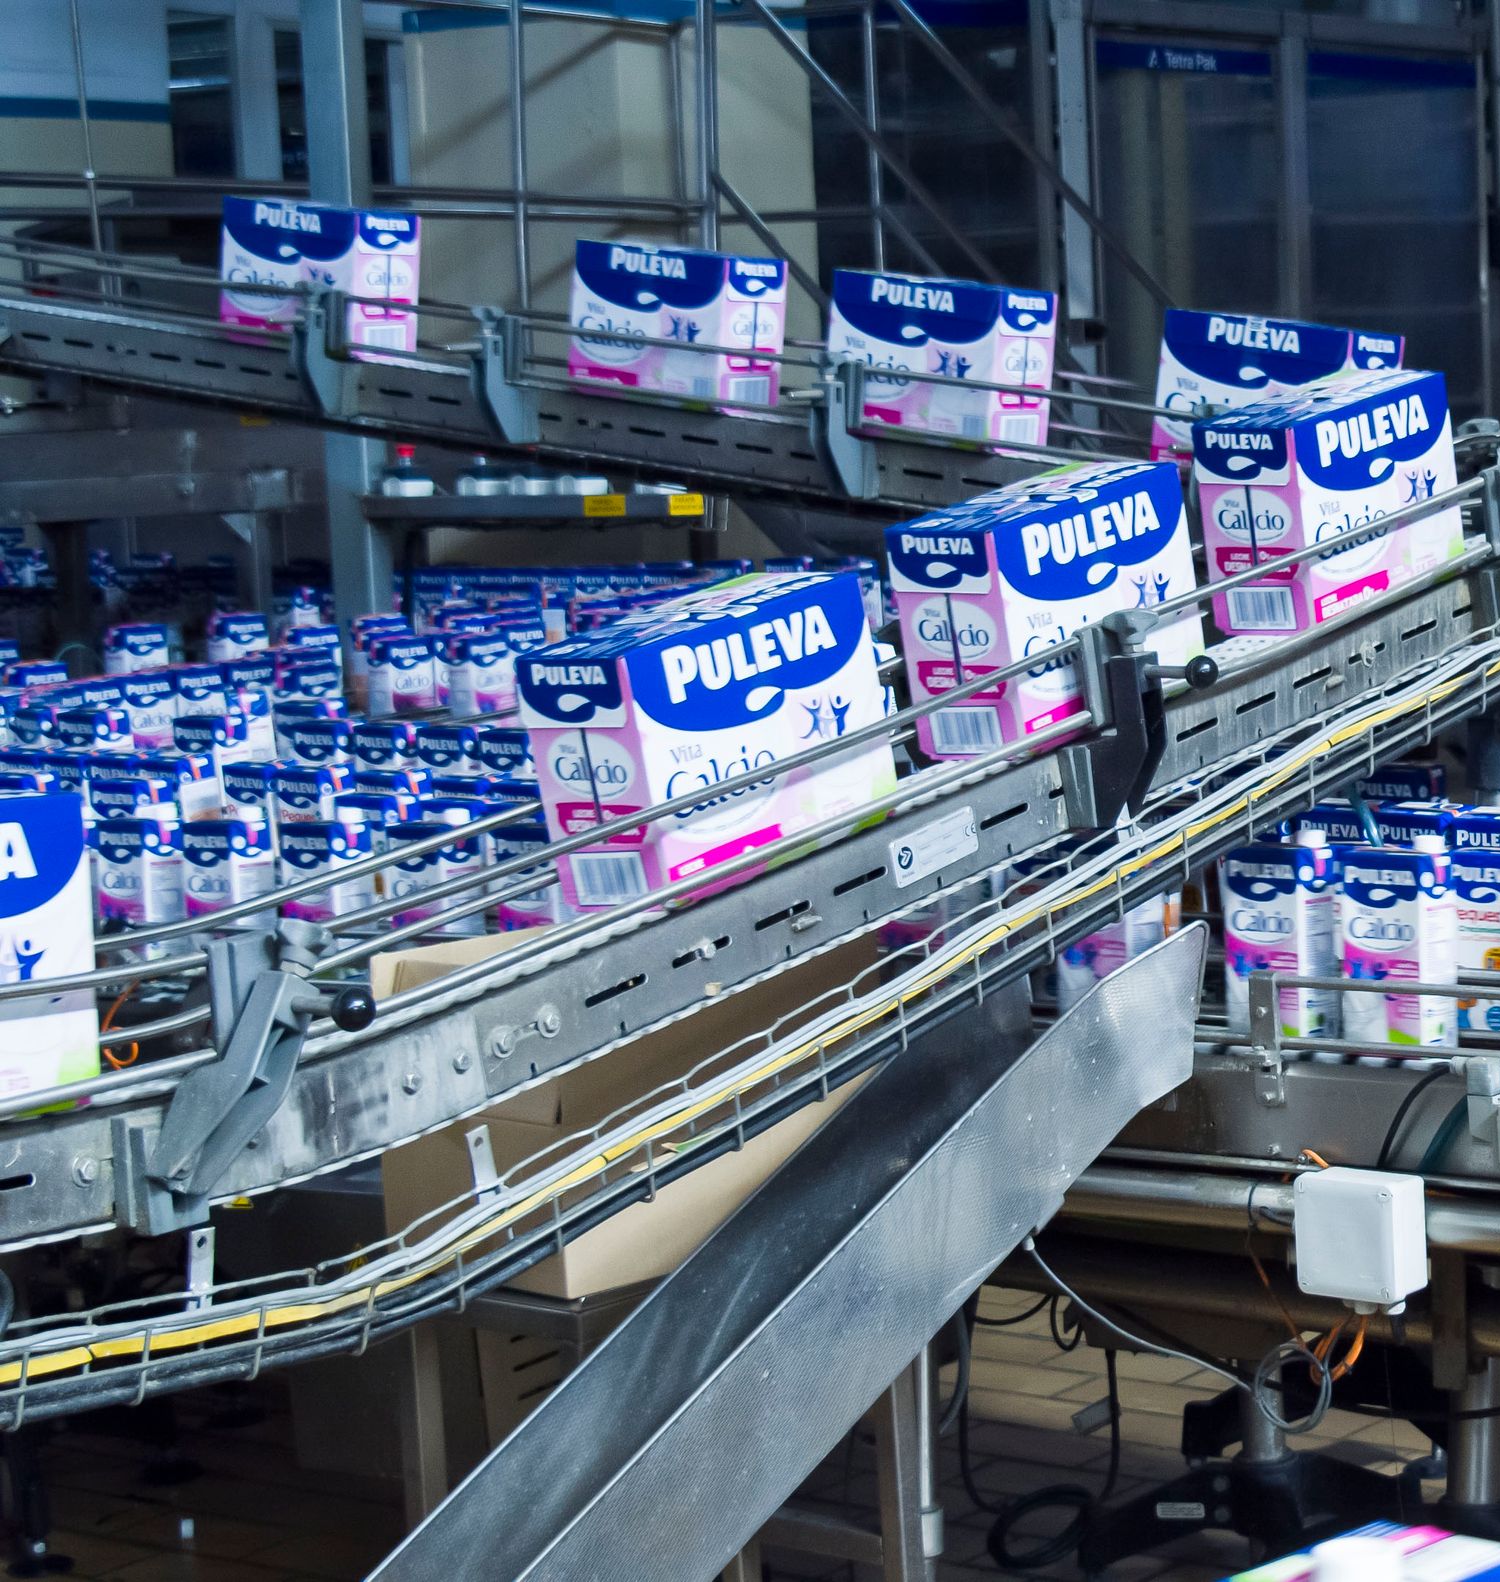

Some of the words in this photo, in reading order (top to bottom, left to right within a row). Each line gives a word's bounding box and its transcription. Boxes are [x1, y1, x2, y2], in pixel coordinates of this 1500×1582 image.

[1164, 51, 1194, 69] Tetra
[1196, 53, 1217, 72] Pak
[254, 203, 322, 234] PULEVA
[365, 215, 411, 232] PULEVA
[610, 247, 687, 280] PULEVA
[734, 261, 778, 277] PULEVA
[870, 277, 955, 314] PULEVA
[1007, 293, 1048, 311] PULEVA
[1207, 316, 1300, 354] PULEVA
[1357, 335, 1395, 354] PULEVA
[1204, 430, 1274, 451] PULEVA
[1314, 393, 1430, 468] PULEVA
[1020, 490, 1161, 576] PULEVA
[901, 534, 975, 556] PULEVA
[1026, 613, 1053, 631] Vita
[660, 604, 838, 705] PULEVA
[530, 663, 608, 687] PULEVA
[668, 743, 704, 765] Vita
[1355, 782, 1413, 798] PULEVA
[1227, 858, 1295, 880] PULEVA
[1344, 864, 1417, 888] PULEVA
[1231, 909, 1295, 934] Calcio
[1349, 915, 1416, 942] Calcio
